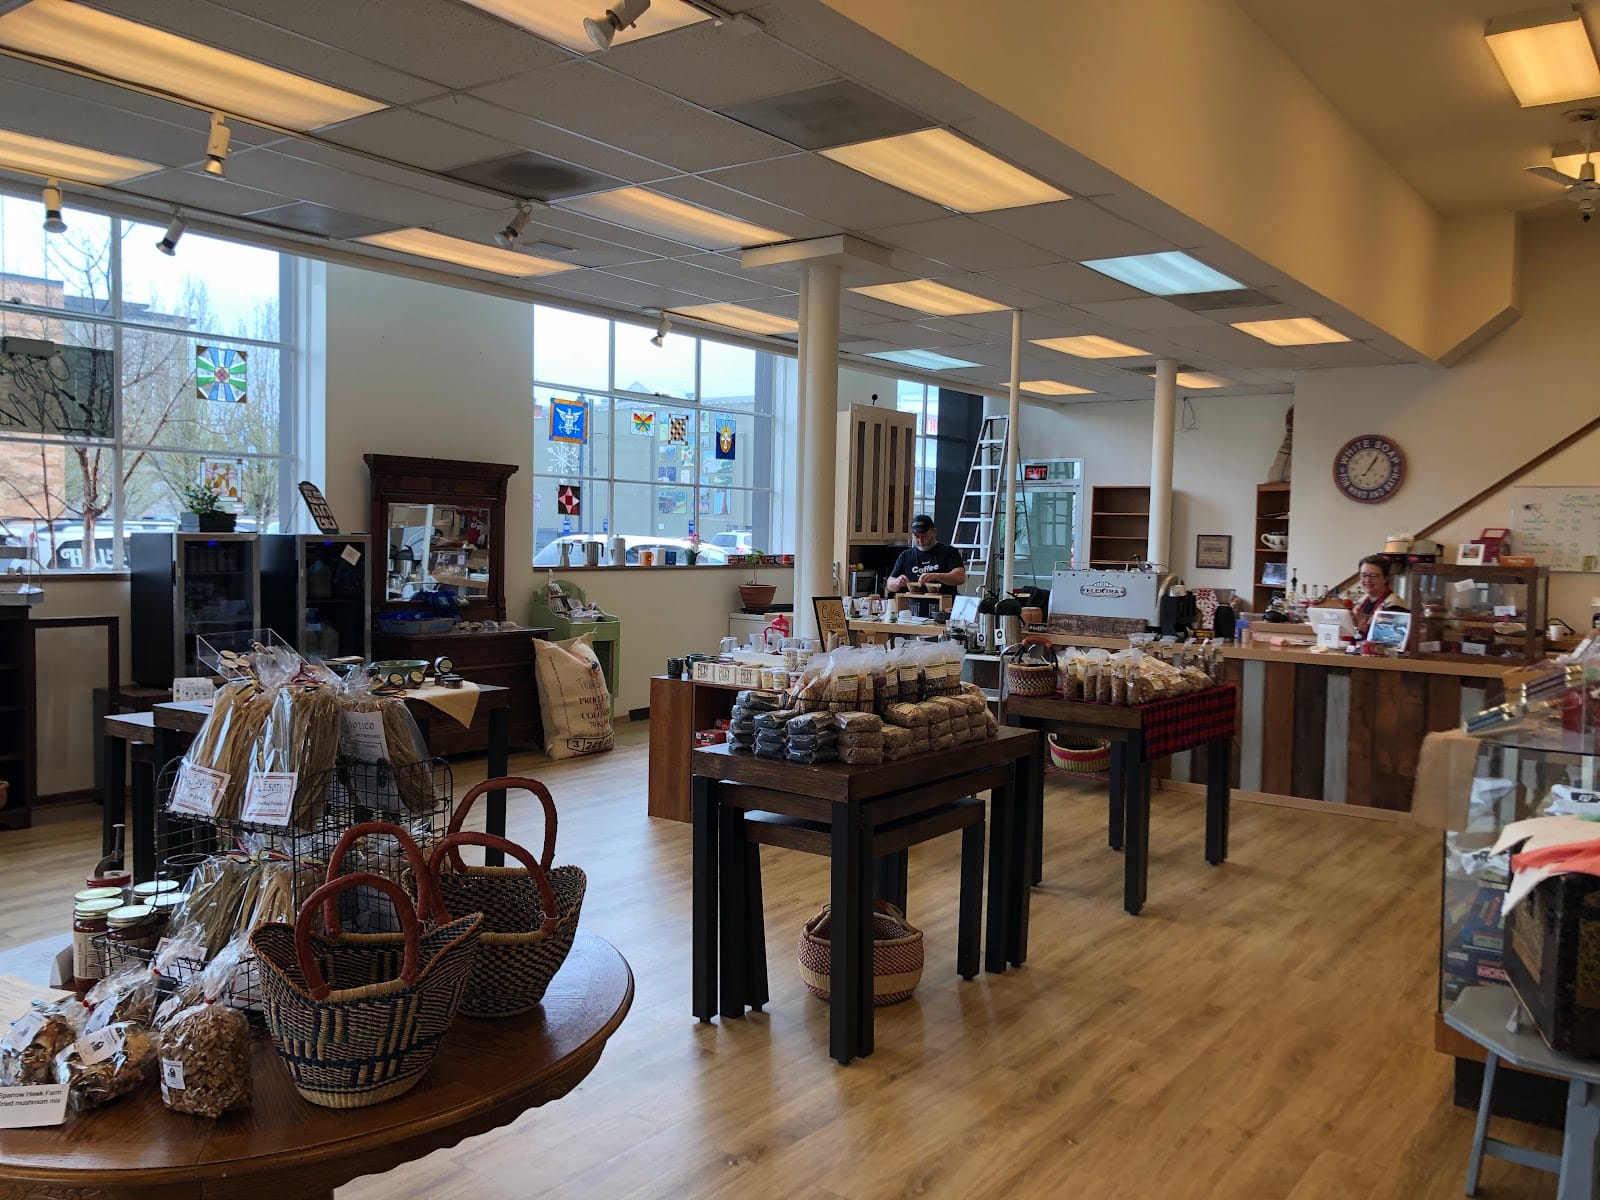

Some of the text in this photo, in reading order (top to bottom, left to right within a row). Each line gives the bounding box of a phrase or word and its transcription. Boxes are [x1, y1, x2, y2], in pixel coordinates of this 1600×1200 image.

[1339, 439, 1400, 465] WHITE SOAP
[1025, 467, 1047, 479] EXIT
[1338, 473, 1351, 488] FOR
[911, 564, 940, 574] Coffee
